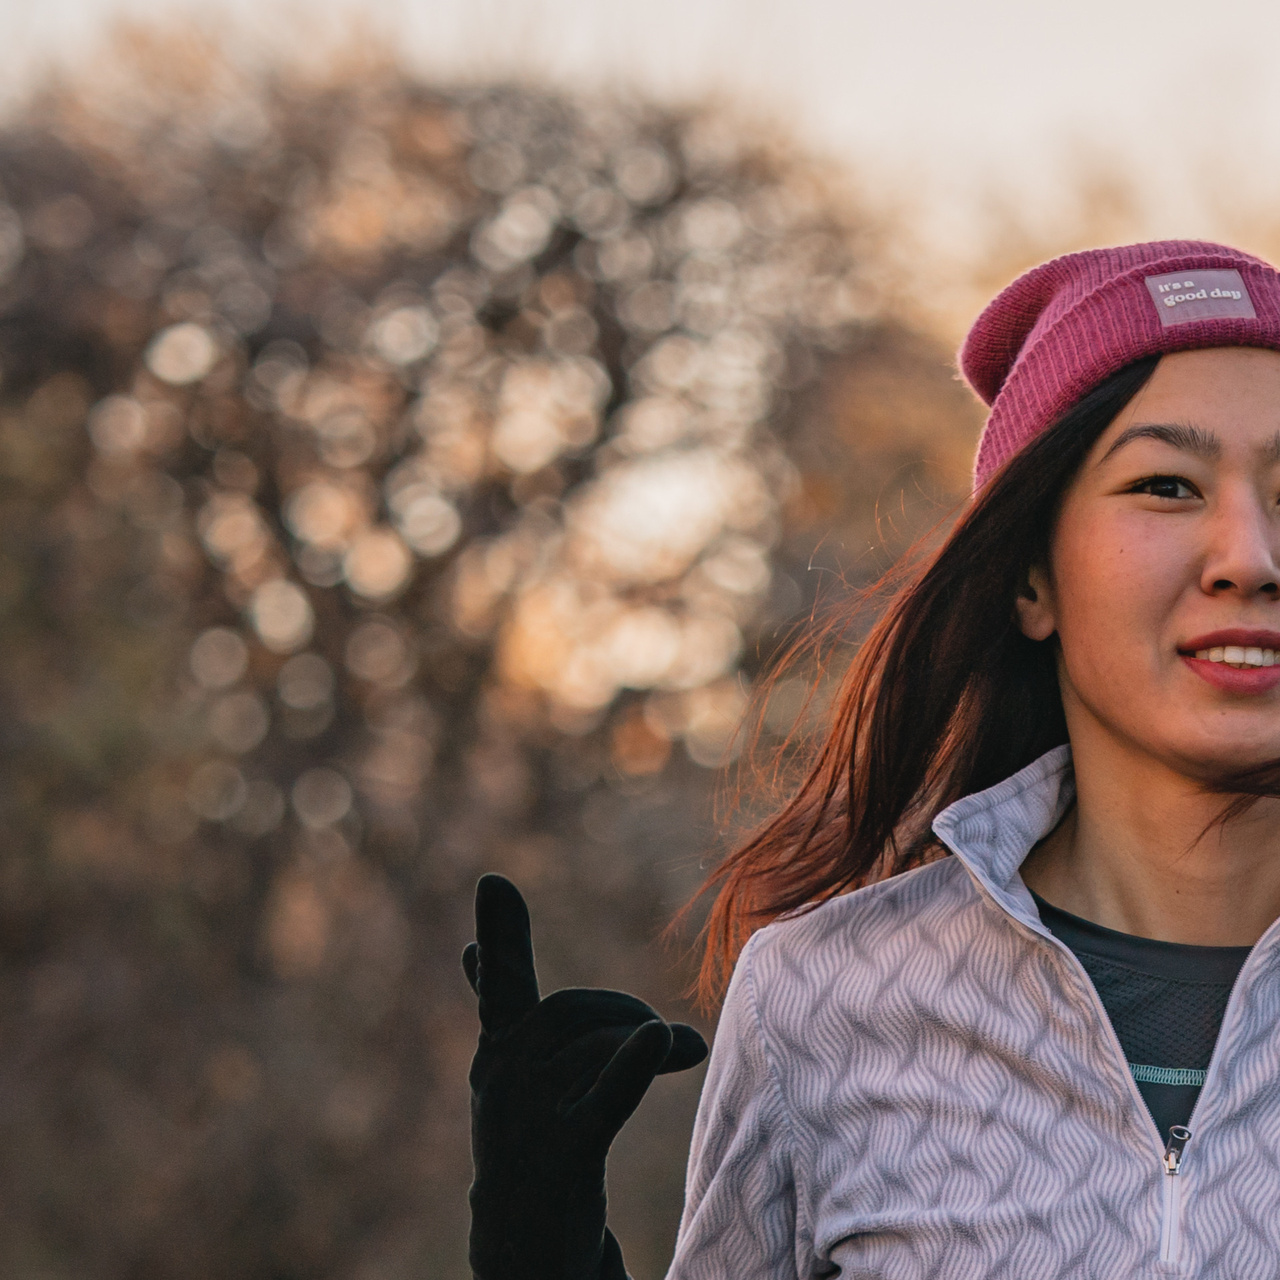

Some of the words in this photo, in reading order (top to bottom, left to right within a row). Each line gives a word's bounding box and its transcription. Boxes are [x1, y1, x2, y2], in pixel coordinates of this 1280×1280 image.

[1184, 280, 1195, 288] a
[1163, 289, 1208, 307] good
[1210, 288, 1242, 300] day
